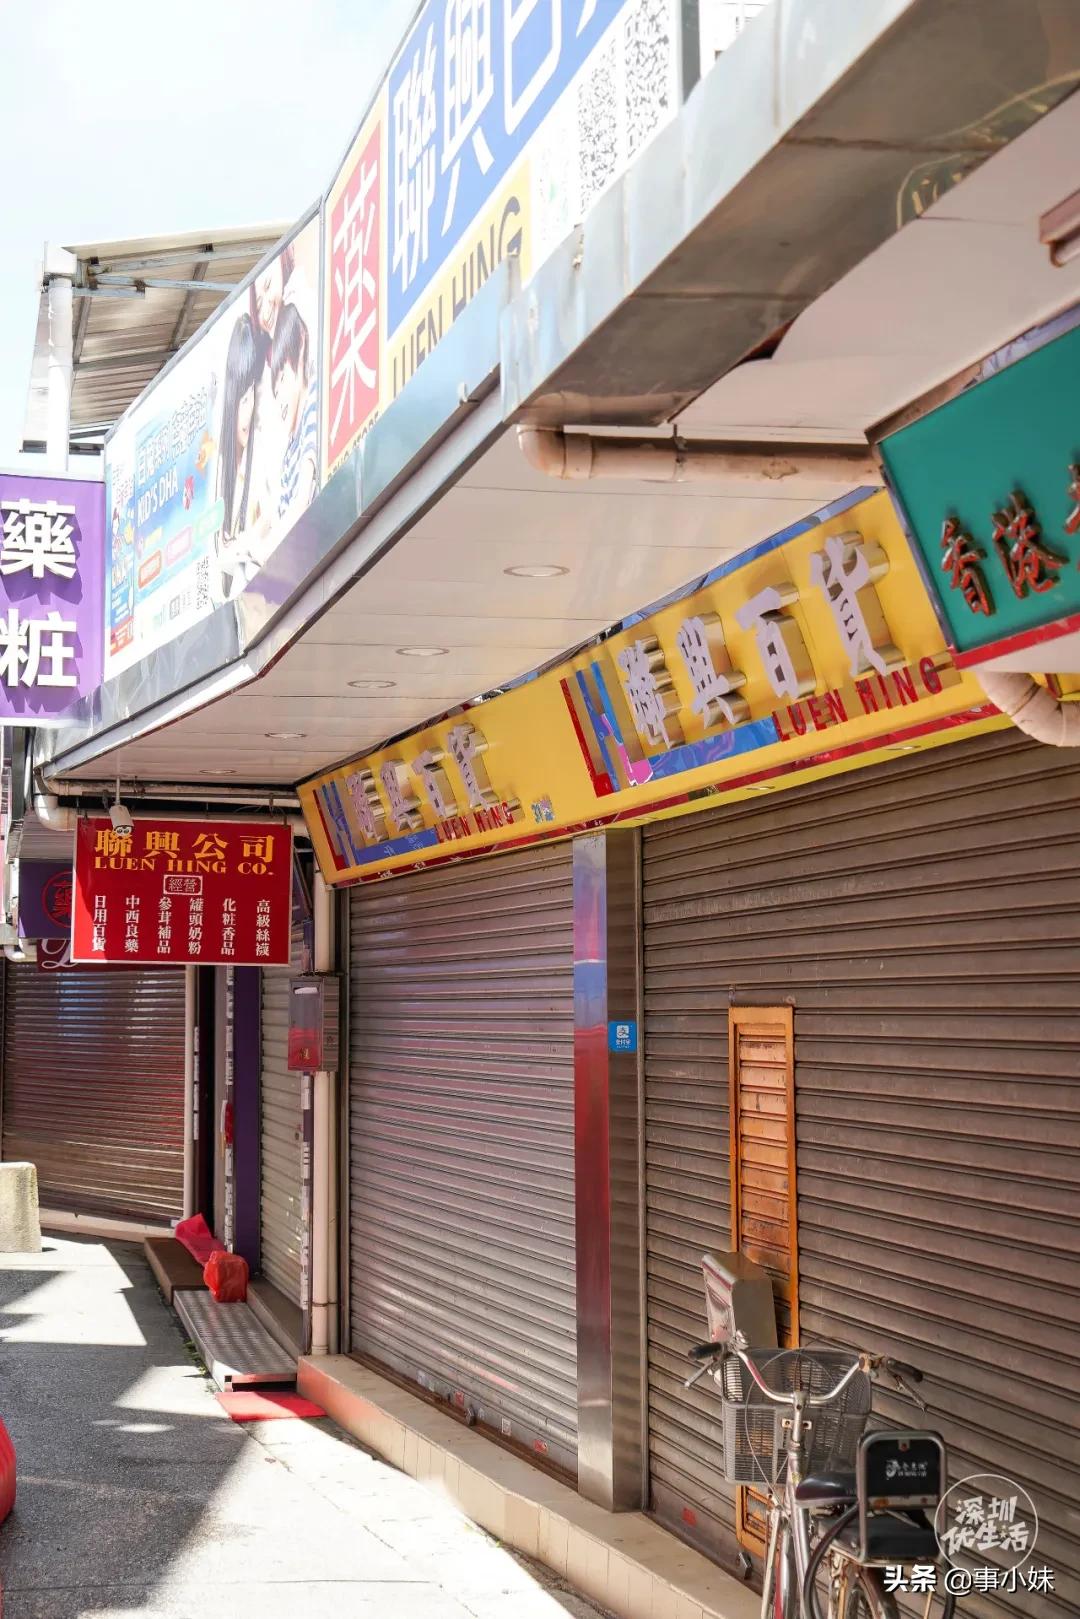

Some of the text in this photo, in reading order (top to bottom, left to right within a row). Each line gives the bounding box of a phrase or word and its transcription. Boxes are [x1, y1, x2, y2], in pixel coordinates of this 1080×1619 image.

[159, 467, 179, 508] DHA
[940, 462, 1080, 618] 香港
[0, 498, 79, 689] 藥粧
[772, 656, 943, 742] LUEN HING
[94, 829, 275, 863] 聯興公司
[94, 856, 275, 876] LUEN HING CO.
[168, 877, 198, 893] 經營
[91, 894, 108, 952] 日用百貨
[124, 894, 140, 953] 中西良藥
[221, 898, 237, 956] 化粧香品
[255, 898, 271, 957] 高級絲襪
